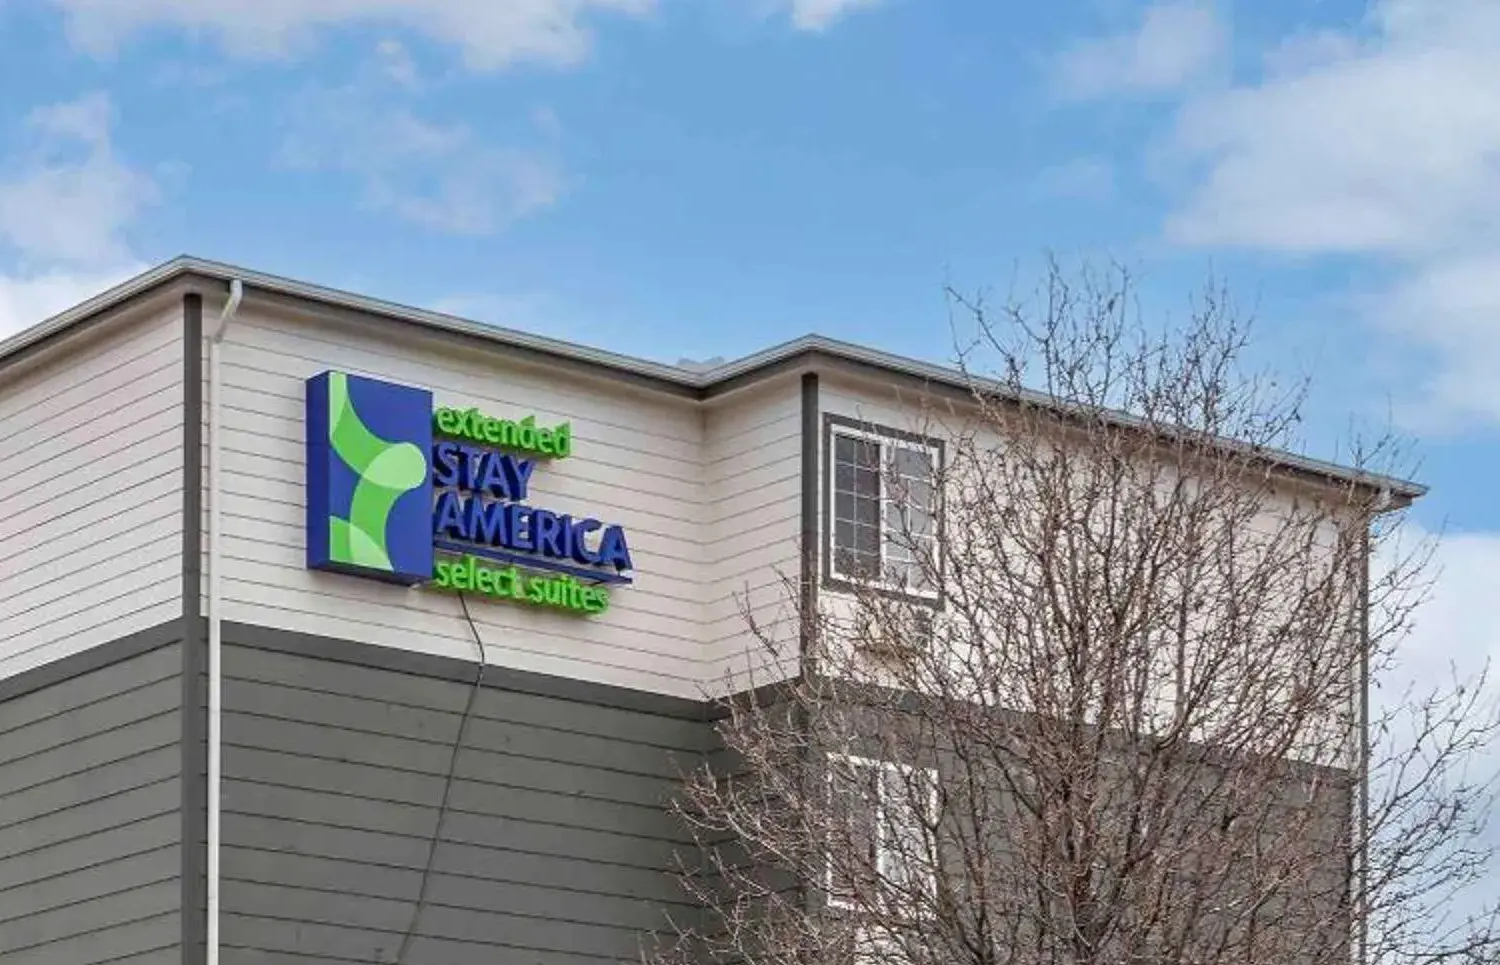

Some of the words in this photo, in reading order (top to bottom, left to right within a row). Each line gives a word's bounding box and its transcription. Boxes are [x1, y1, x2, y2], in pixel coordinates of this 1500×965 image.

[435, 406, 570, 458] extended
[433, 441, 536, 502] STAY
[434, 490, 634, 571] AMERICA
[435, 556, 521, 598] select
[528, 574, 609, 613] suites
